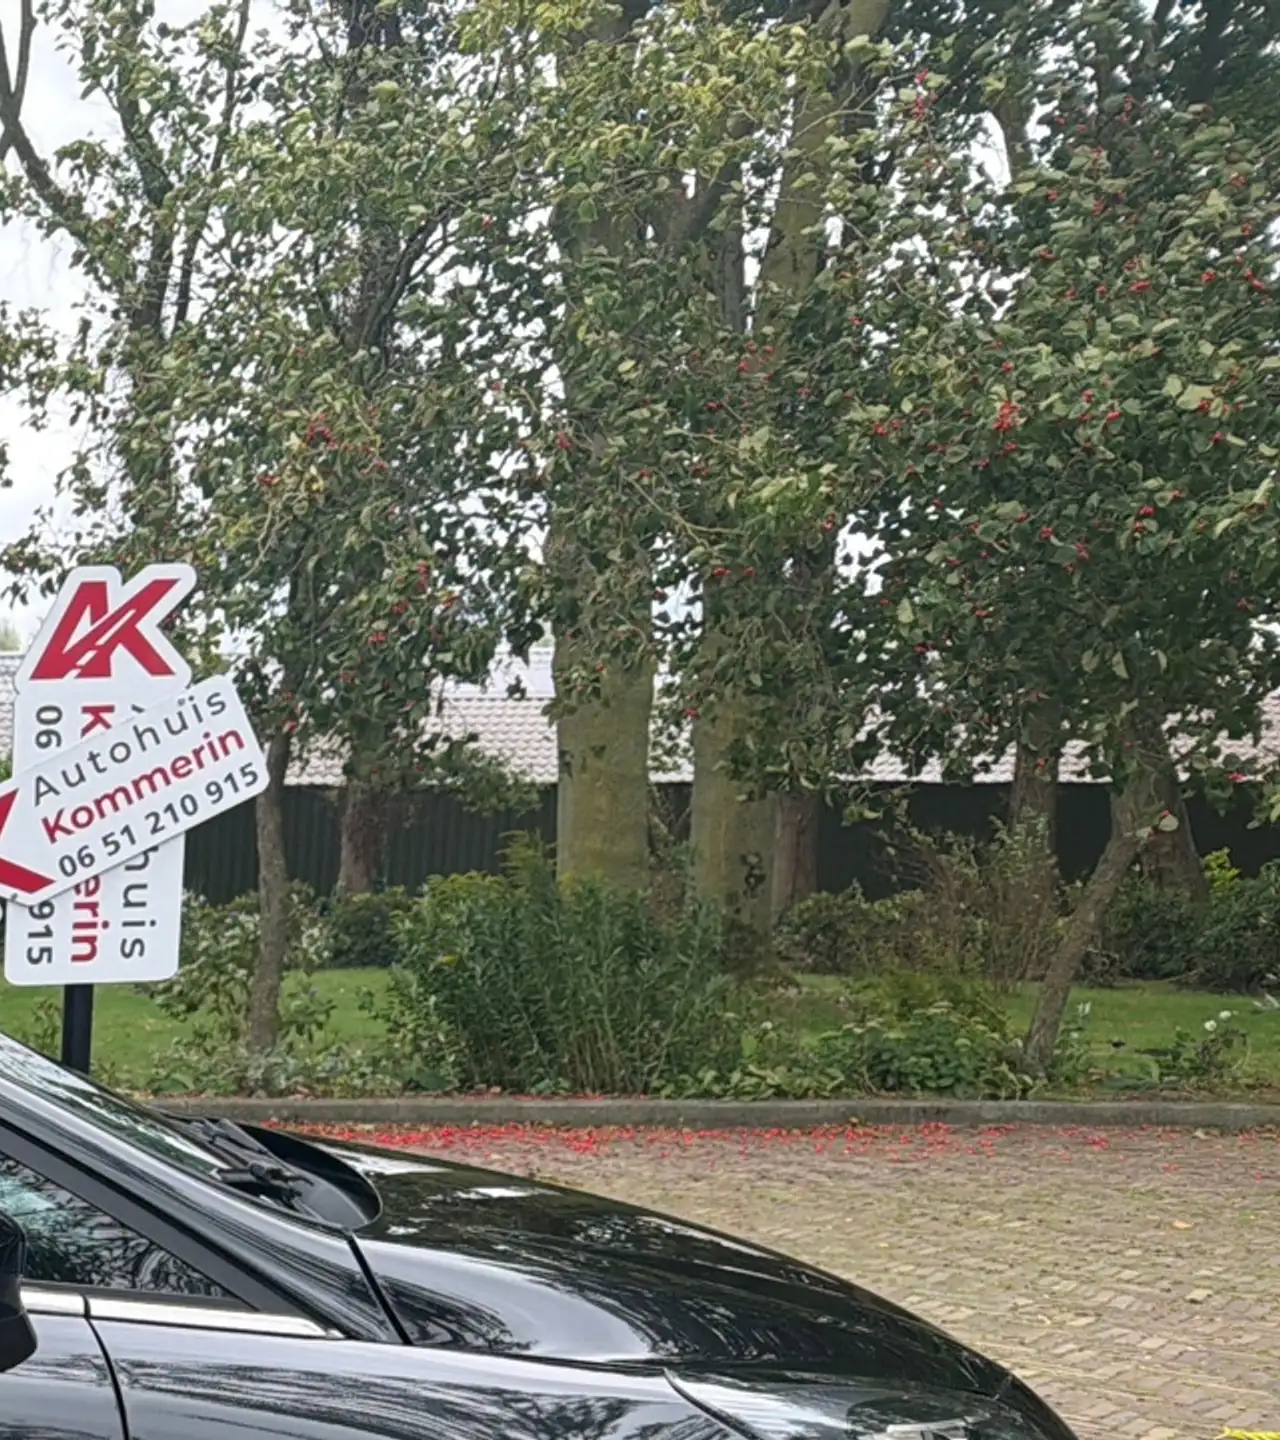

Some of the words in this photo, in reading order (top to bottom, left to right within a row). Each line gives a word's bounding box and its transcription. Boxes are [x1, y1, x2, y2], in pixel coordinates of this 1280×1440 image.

[34, 691, 227, 807] Autohuis
[35, 705, 63, 749] 06
[41, 729, 245, 845] Kommerin
[58, 845, 96, 877] 06
[101, 824, 137, 857] 51
[144, 793, 199, 835] 210
[204, 762, 259, 804] 915
[26, 900, 56, 965] 915
